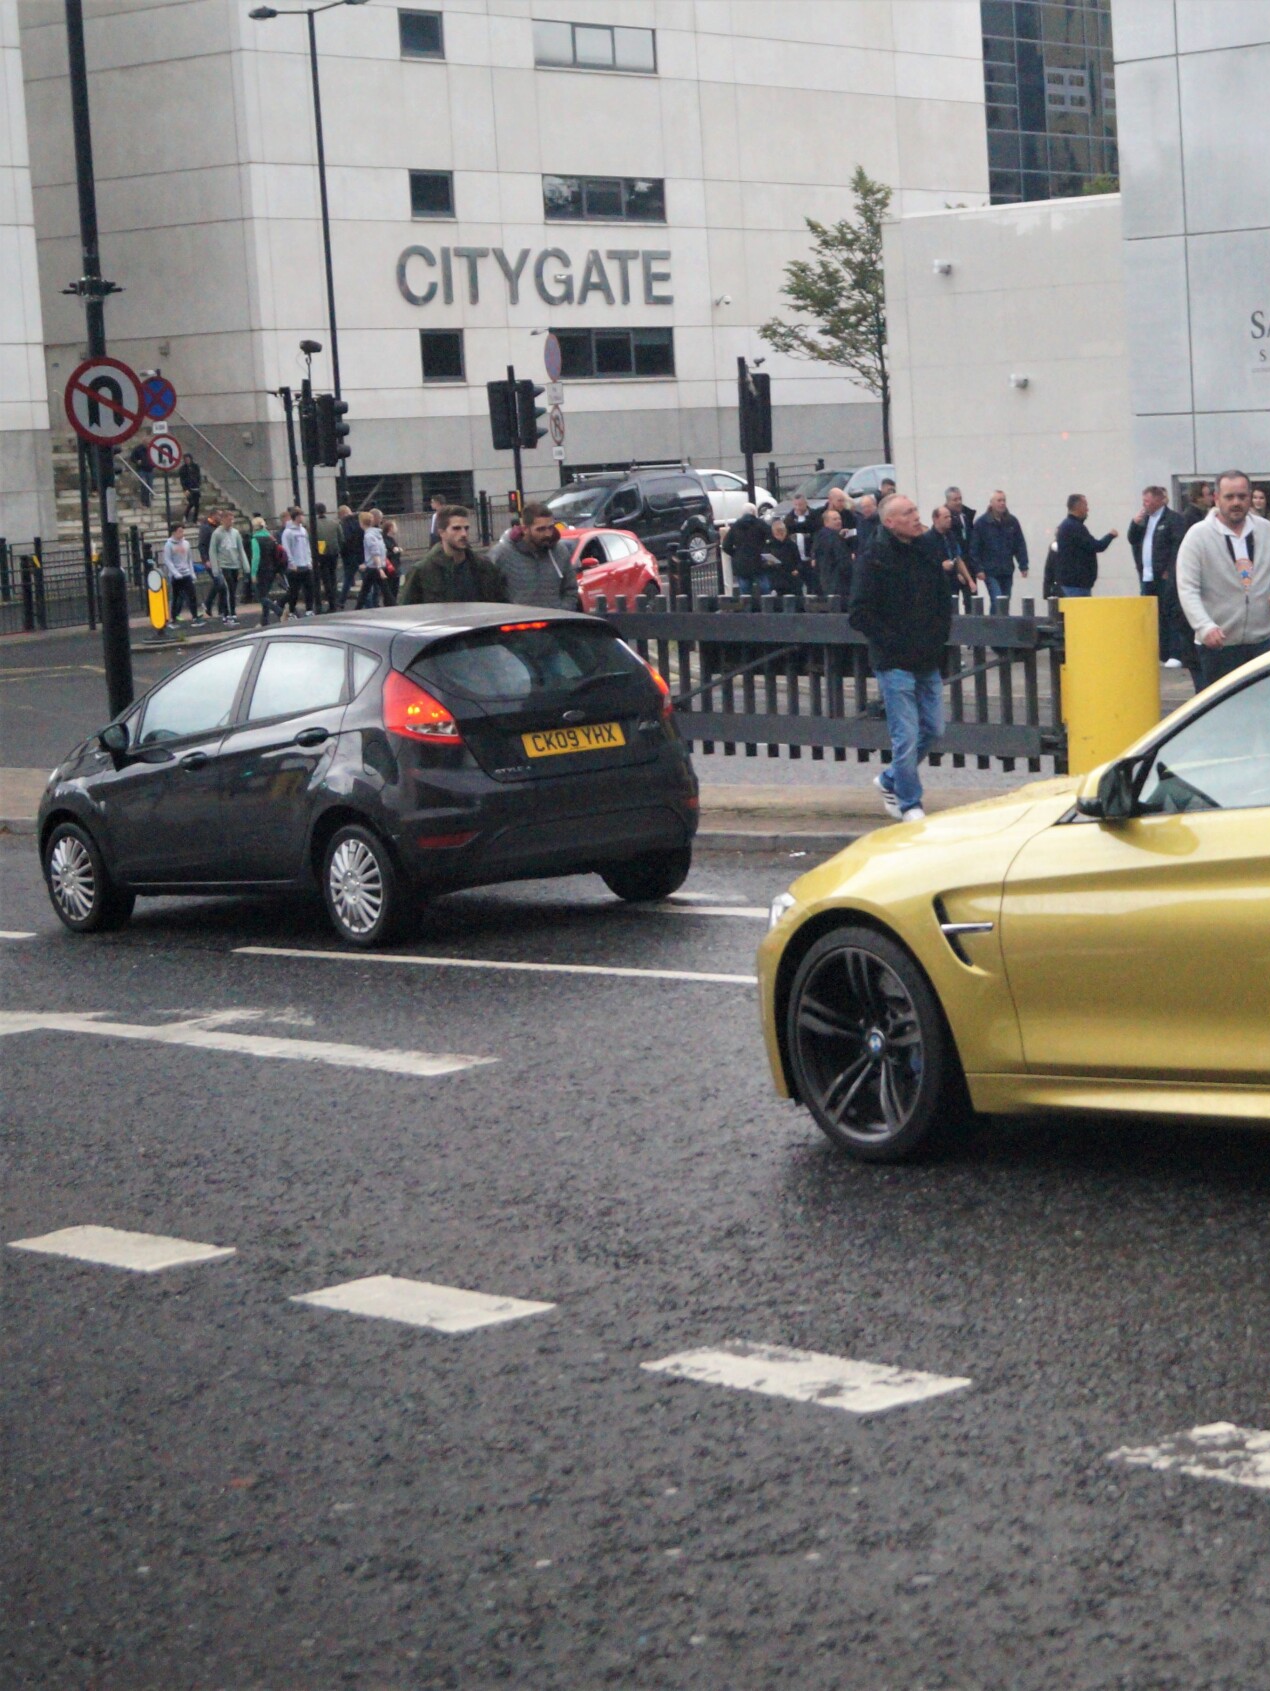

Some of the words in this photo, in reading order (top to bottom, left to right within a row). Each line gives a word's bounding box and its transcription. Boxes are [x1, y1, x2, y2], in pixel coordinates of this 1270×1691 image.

[396, 245, 674, 306] CITYGATE
[531, 730, 579, 752] CK09
[582, 725, 617, 745] YHX
